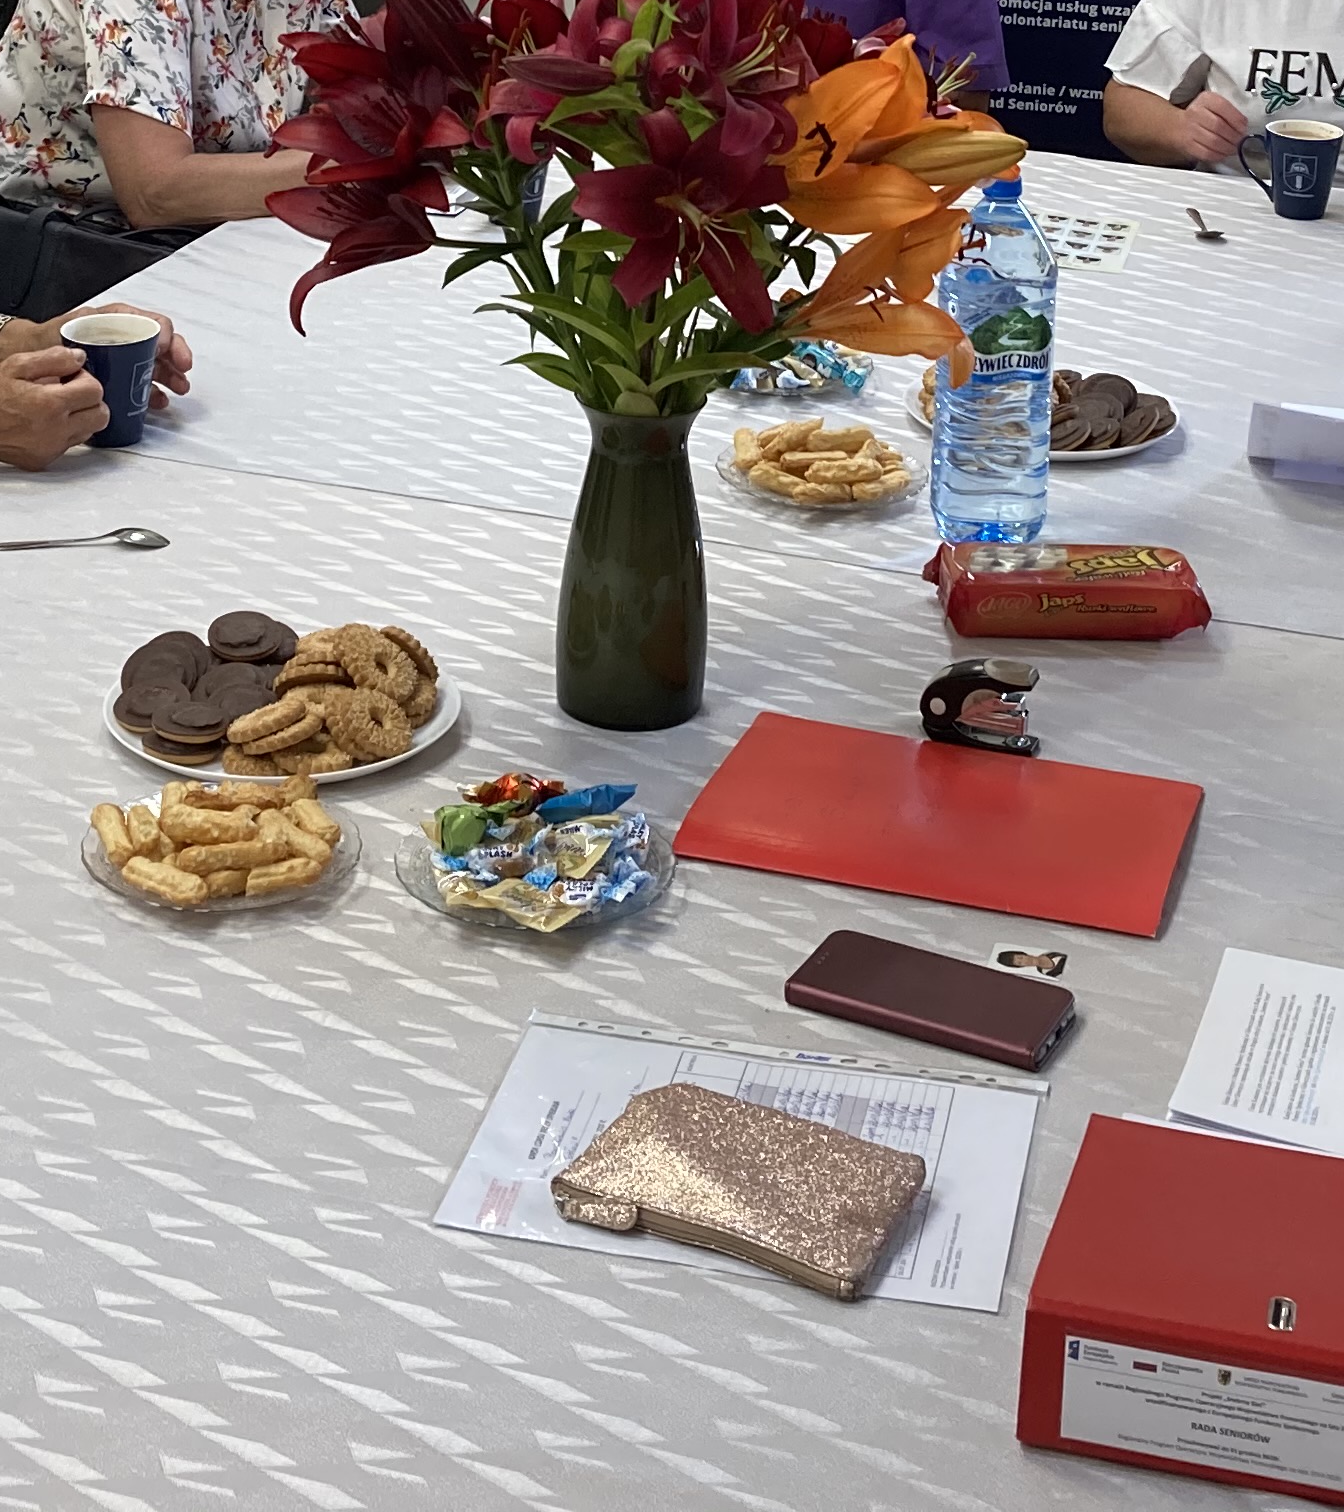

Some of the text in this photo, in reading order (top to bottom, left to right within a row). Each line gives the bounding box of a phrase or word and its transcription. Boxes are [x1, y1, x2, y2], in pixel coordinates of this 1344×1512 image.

[1056, 0, 1099, 18] usług
[1007, 98, 1077, 115] Seniorów
[1038, 593, 1086, 613] Japs
[1190, 1421, 1271, 1444] RADA SENIORÓW
